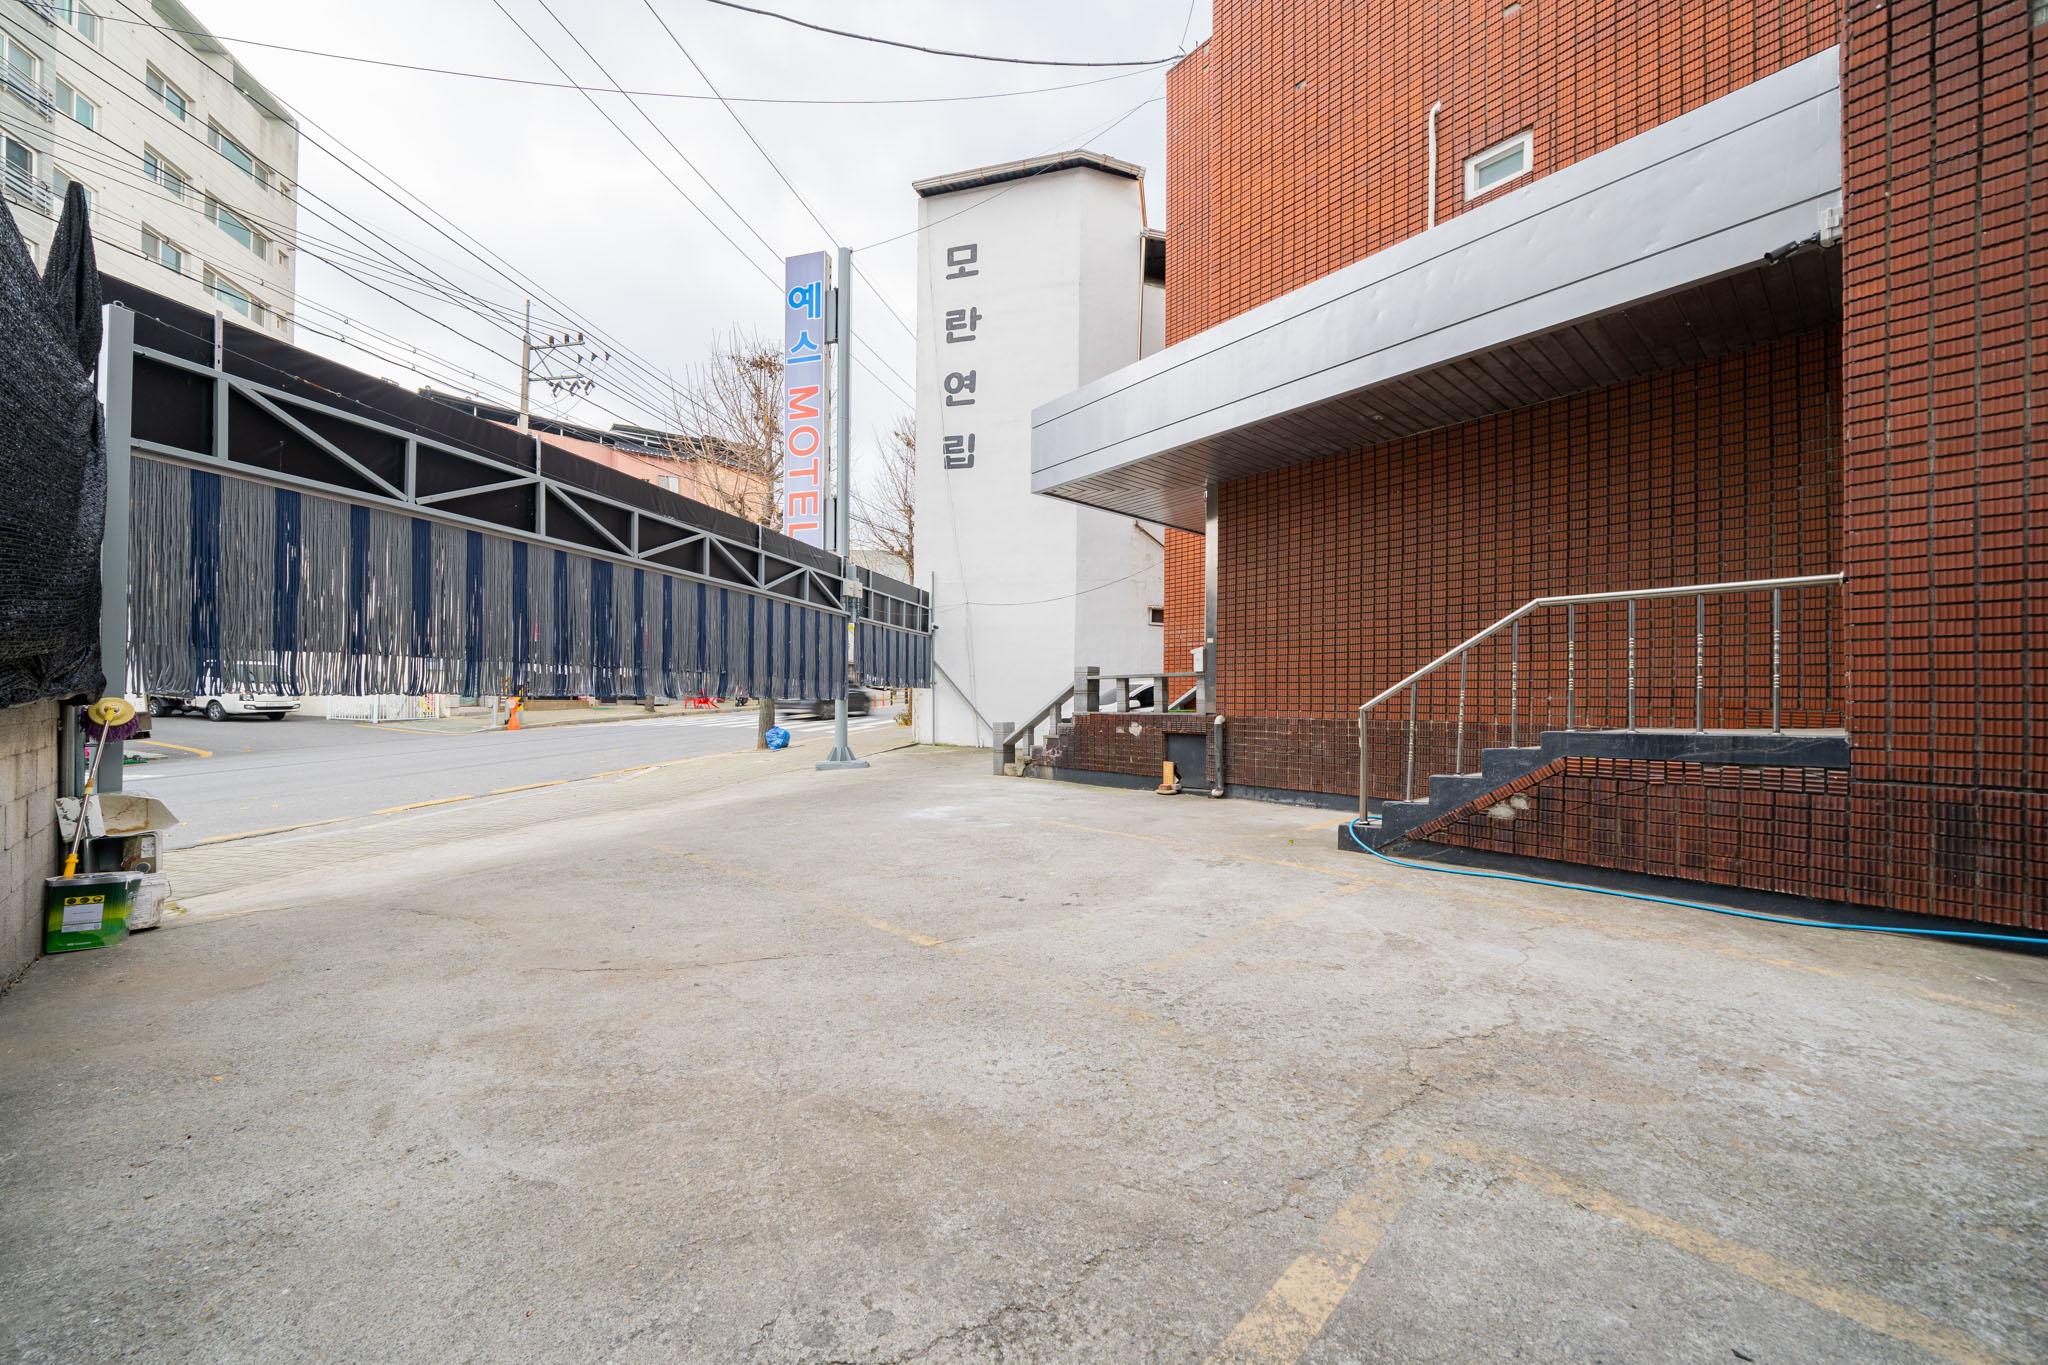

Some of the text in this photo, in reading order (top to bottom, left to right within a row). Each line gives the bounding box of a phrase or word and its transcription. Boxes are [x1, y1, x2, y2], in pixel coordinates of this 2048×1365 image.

[787, 281, 822, 539] 예스 MOTEL
[943, 243, 982, 470] 모란연립
